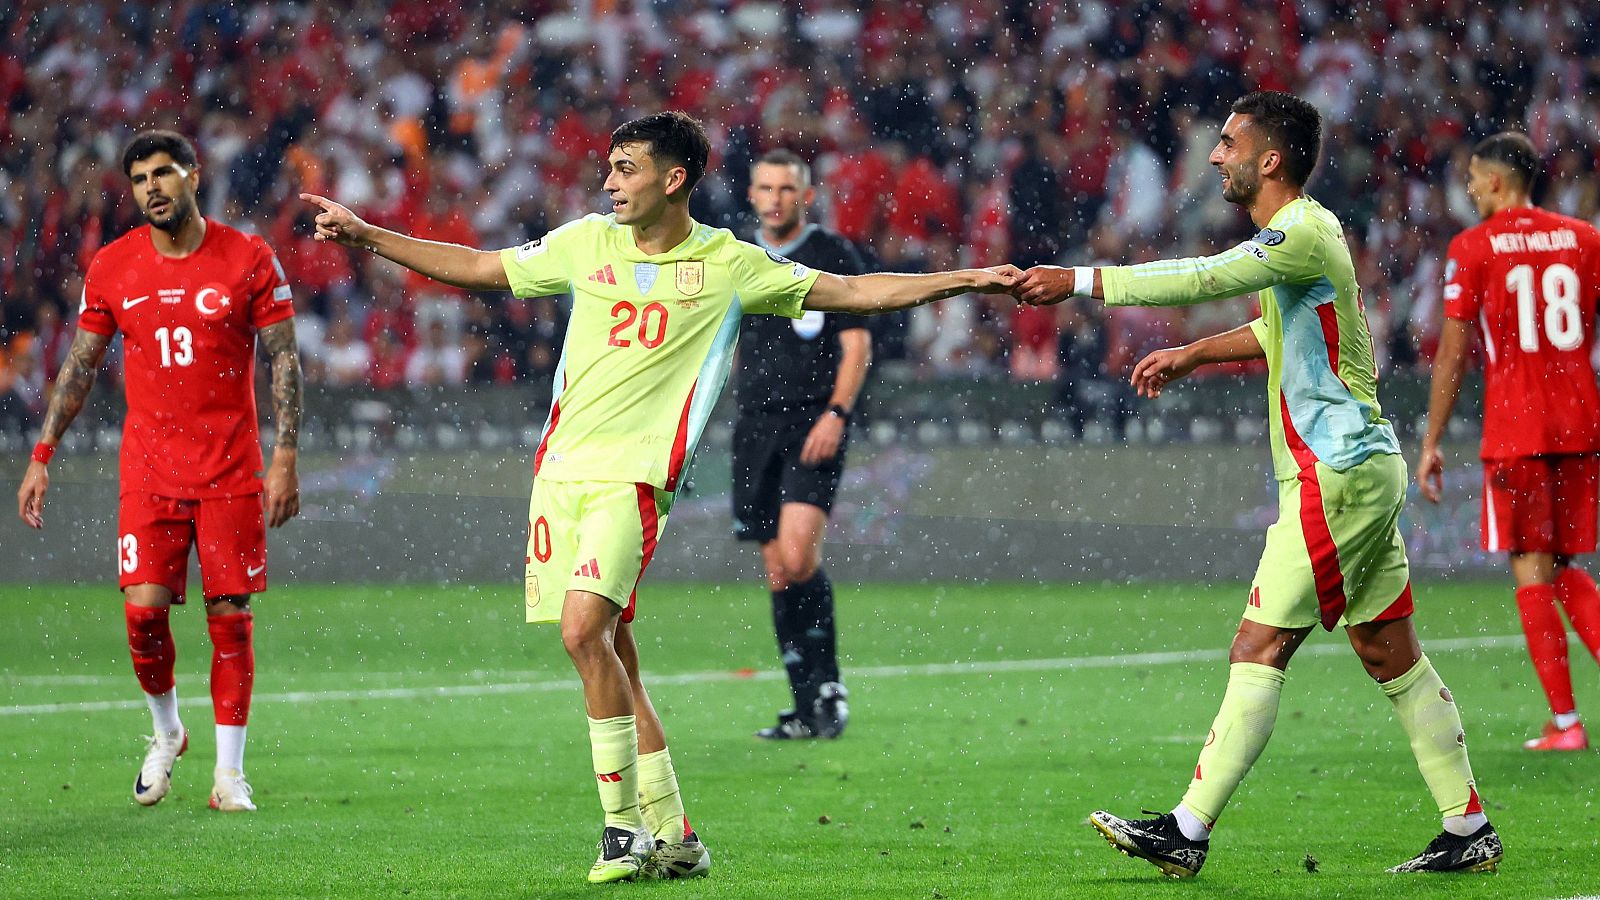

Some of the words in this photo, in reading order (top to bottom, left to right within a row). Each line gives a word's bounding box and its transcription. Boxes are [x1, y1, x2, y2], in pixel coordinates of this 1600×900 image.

[1489, 232, 1526, 255] MERT
[608, 300, 669, 349] 20
[1506, 263, 1584, 352] 18
[155, 326, 194, 368] 13
[524, 515, 552, 563] 0
